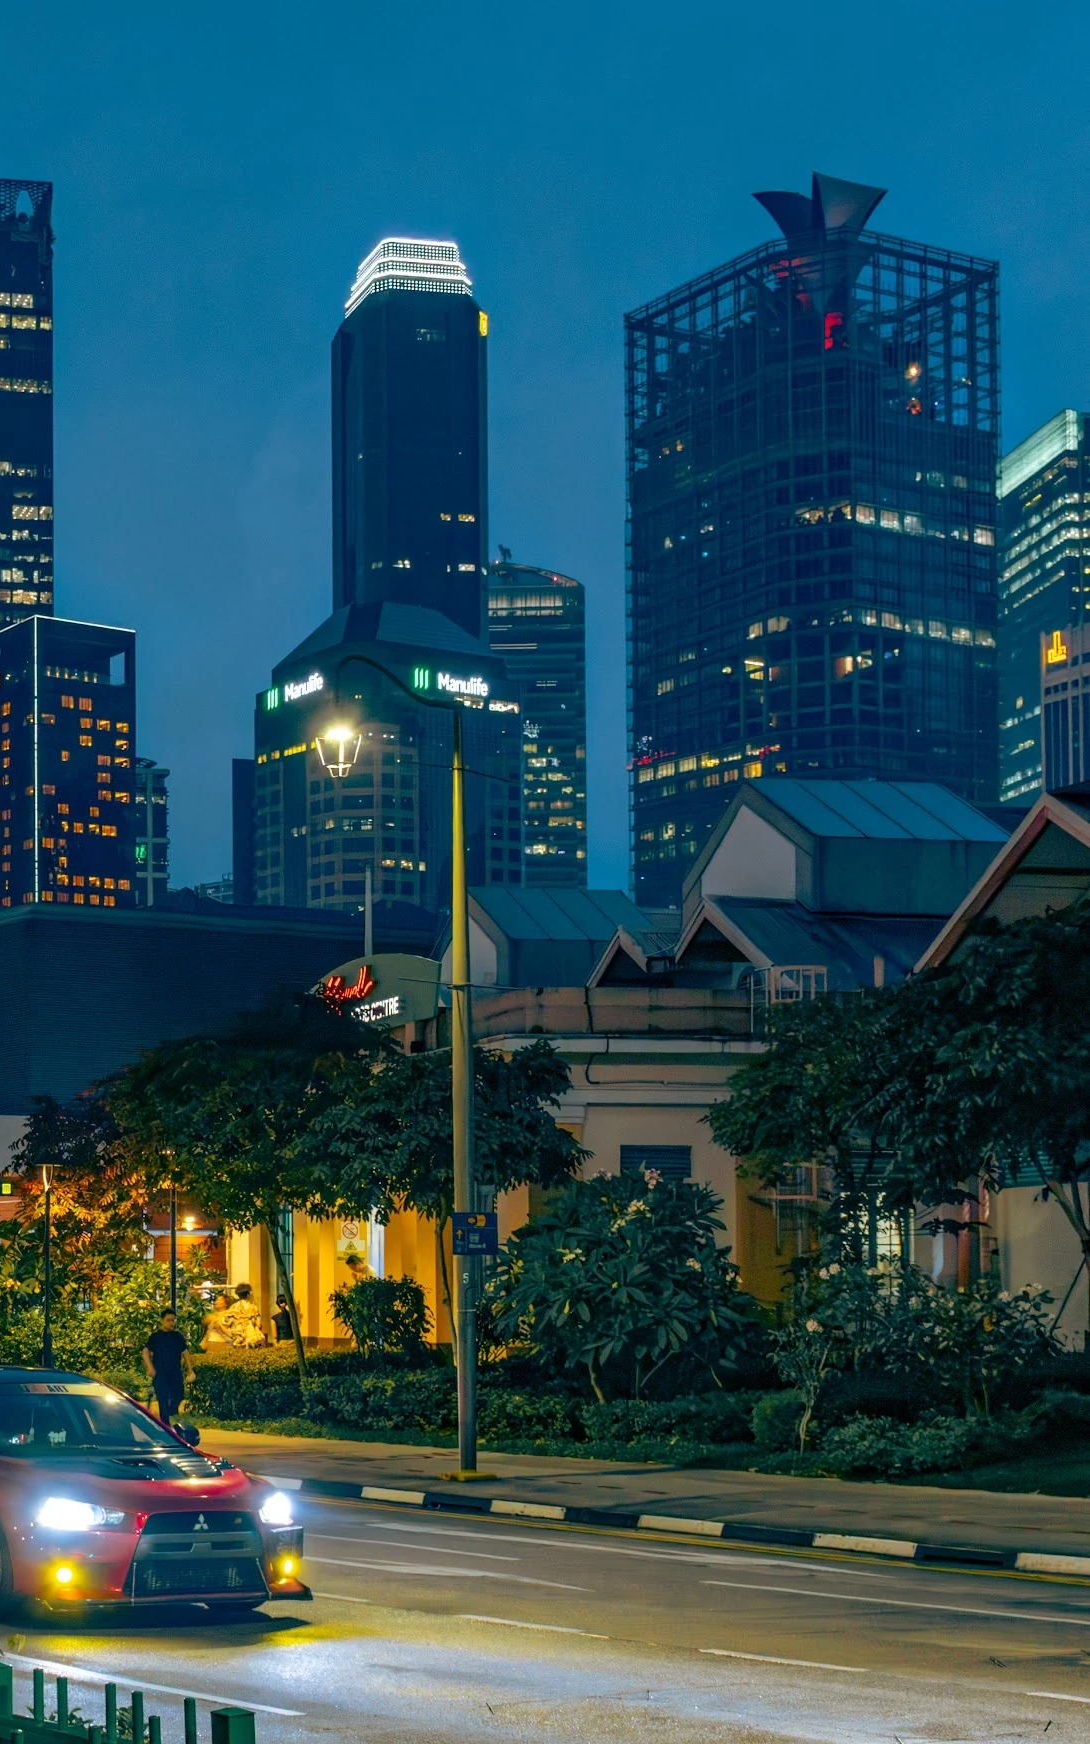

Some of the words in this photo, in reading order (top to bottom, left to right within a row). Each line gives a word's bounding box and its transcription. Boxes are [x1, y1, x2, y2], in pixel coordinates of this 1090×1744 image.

[284, 672, 324, 702] Manulife
[437, 672, 489, 697] Manulife
[462, 1272, 470, 1285] 5
